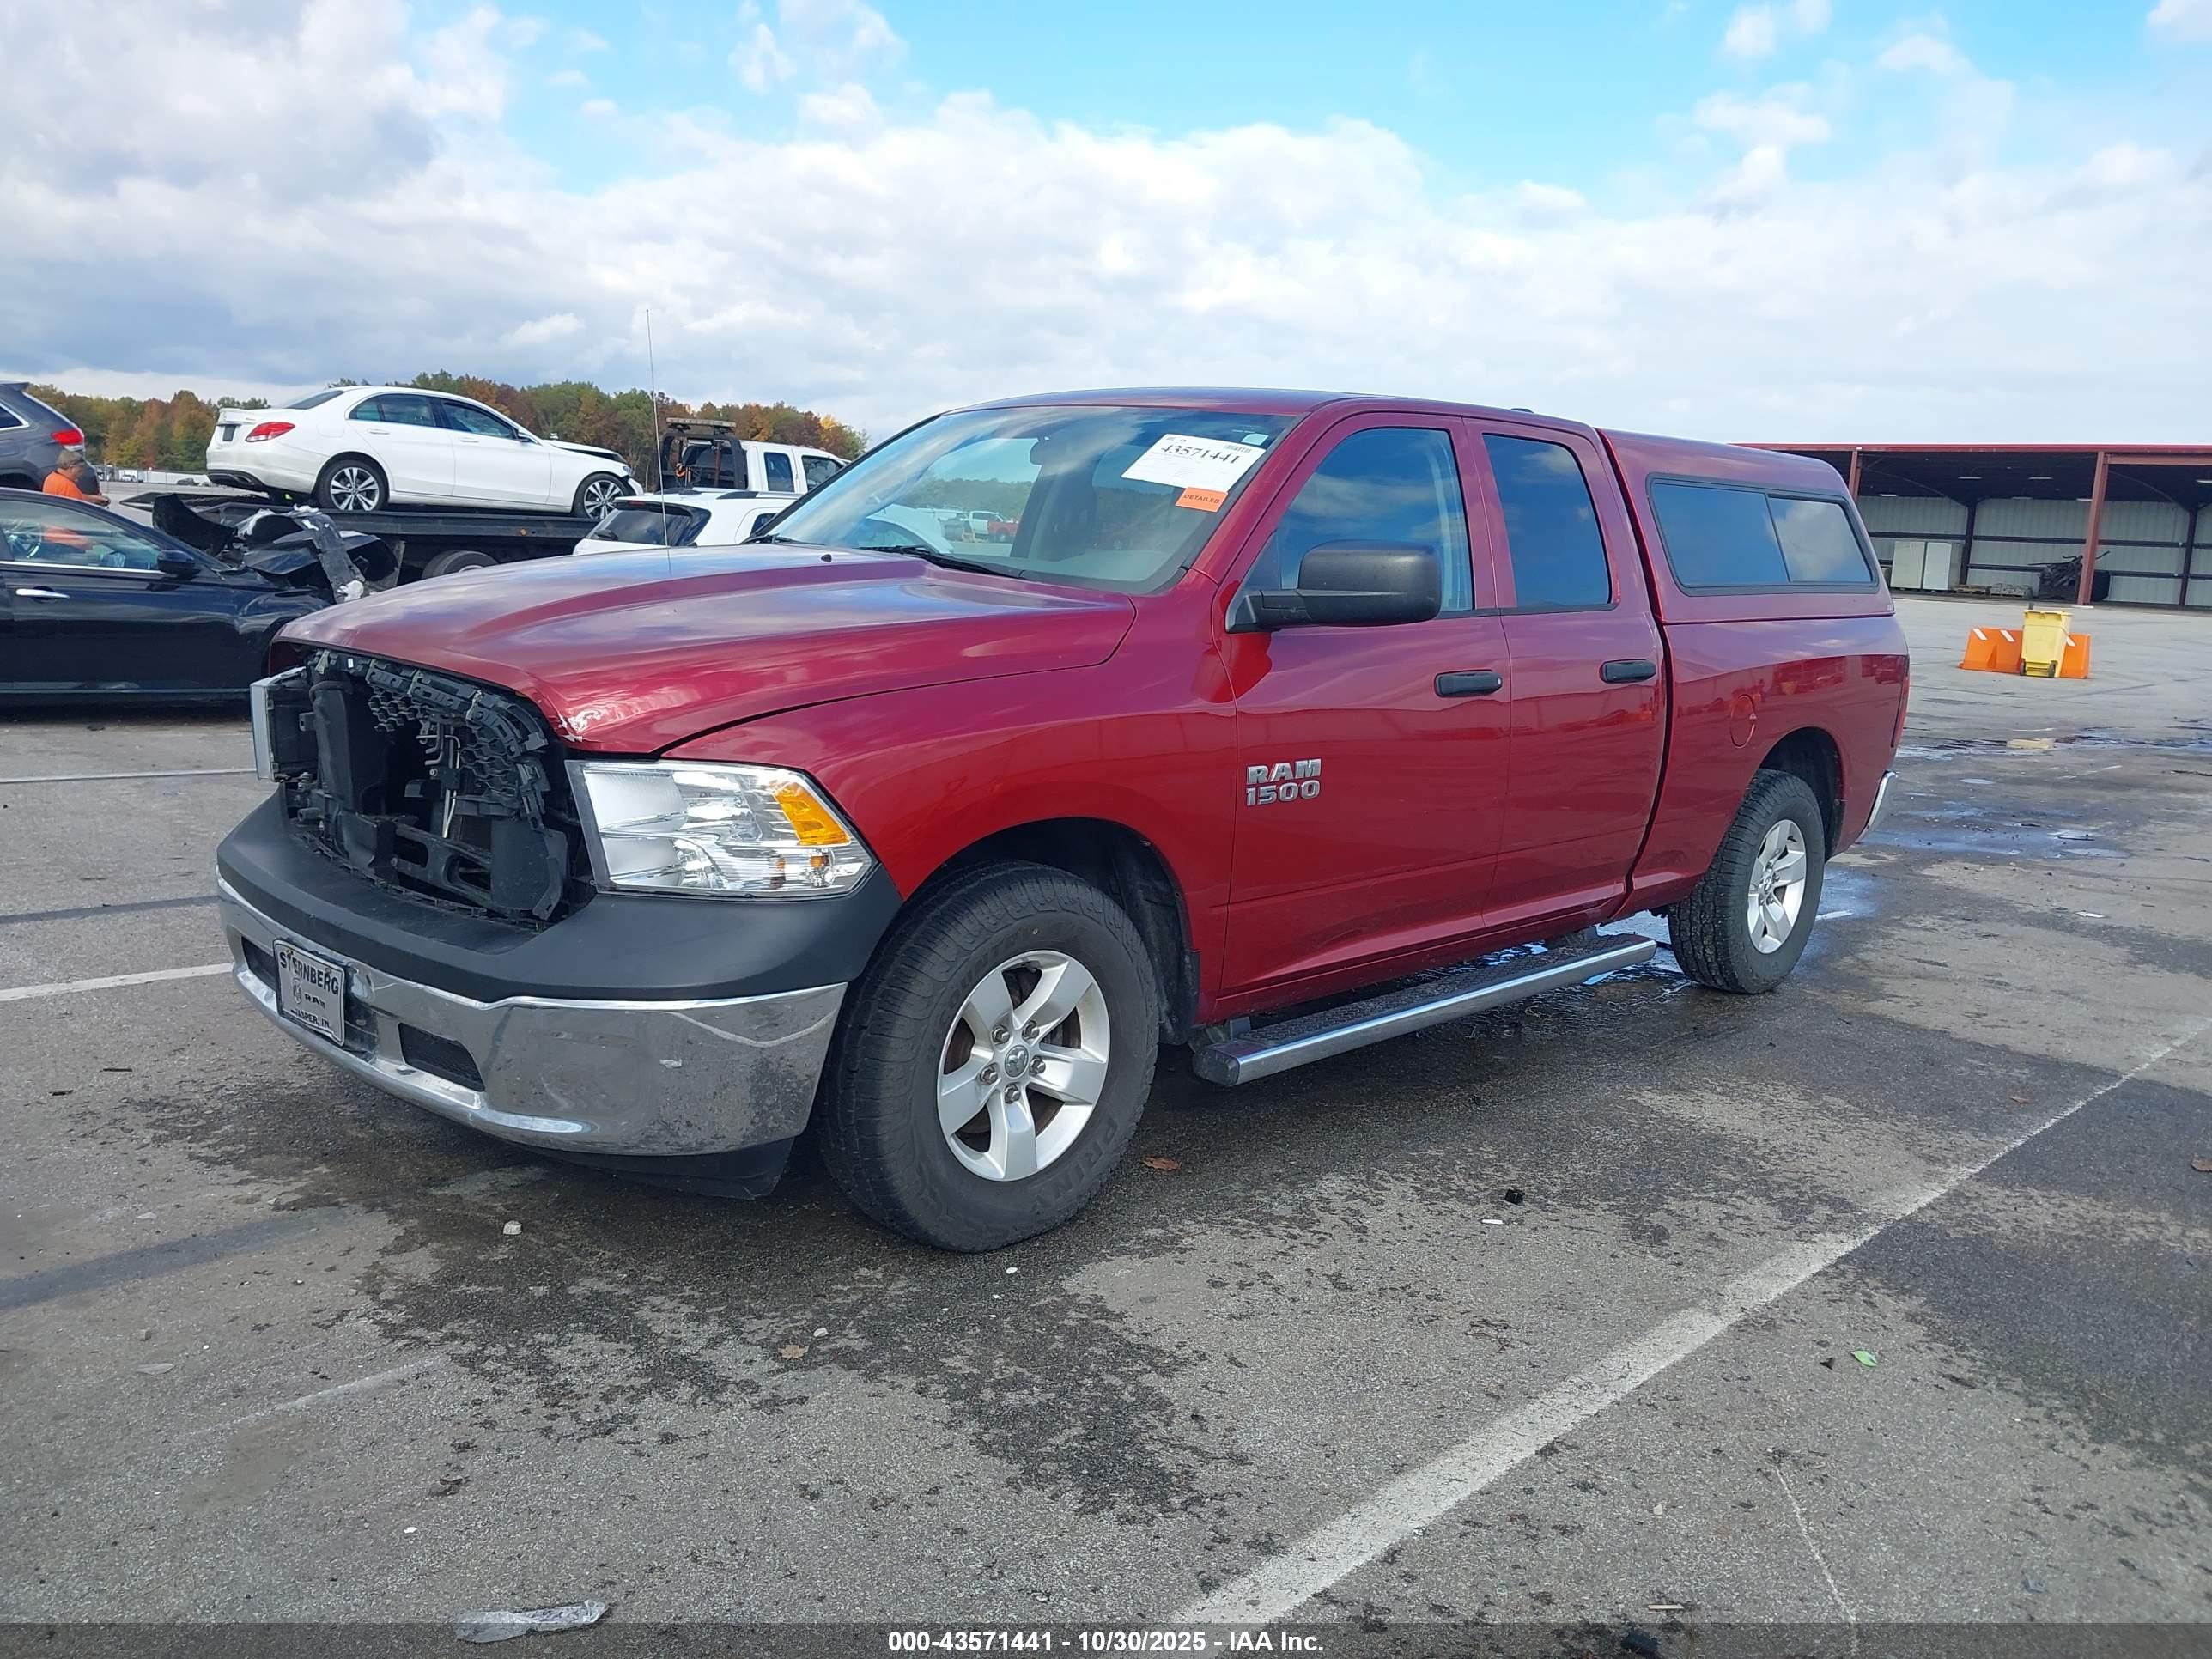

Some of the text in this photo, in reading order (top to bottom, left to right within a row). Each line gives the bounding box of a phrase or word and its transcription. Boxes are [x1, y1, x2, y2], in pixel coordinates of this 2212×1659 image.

[1161, 444, 1240, 465] 43571441
[1183, 494, 1220, 505] DETAILED
[1247, 759, 1322, 785] RAM
[1246, 781, 1321, 806] 1500
[279, 951, 339, 995] STERNBERG
